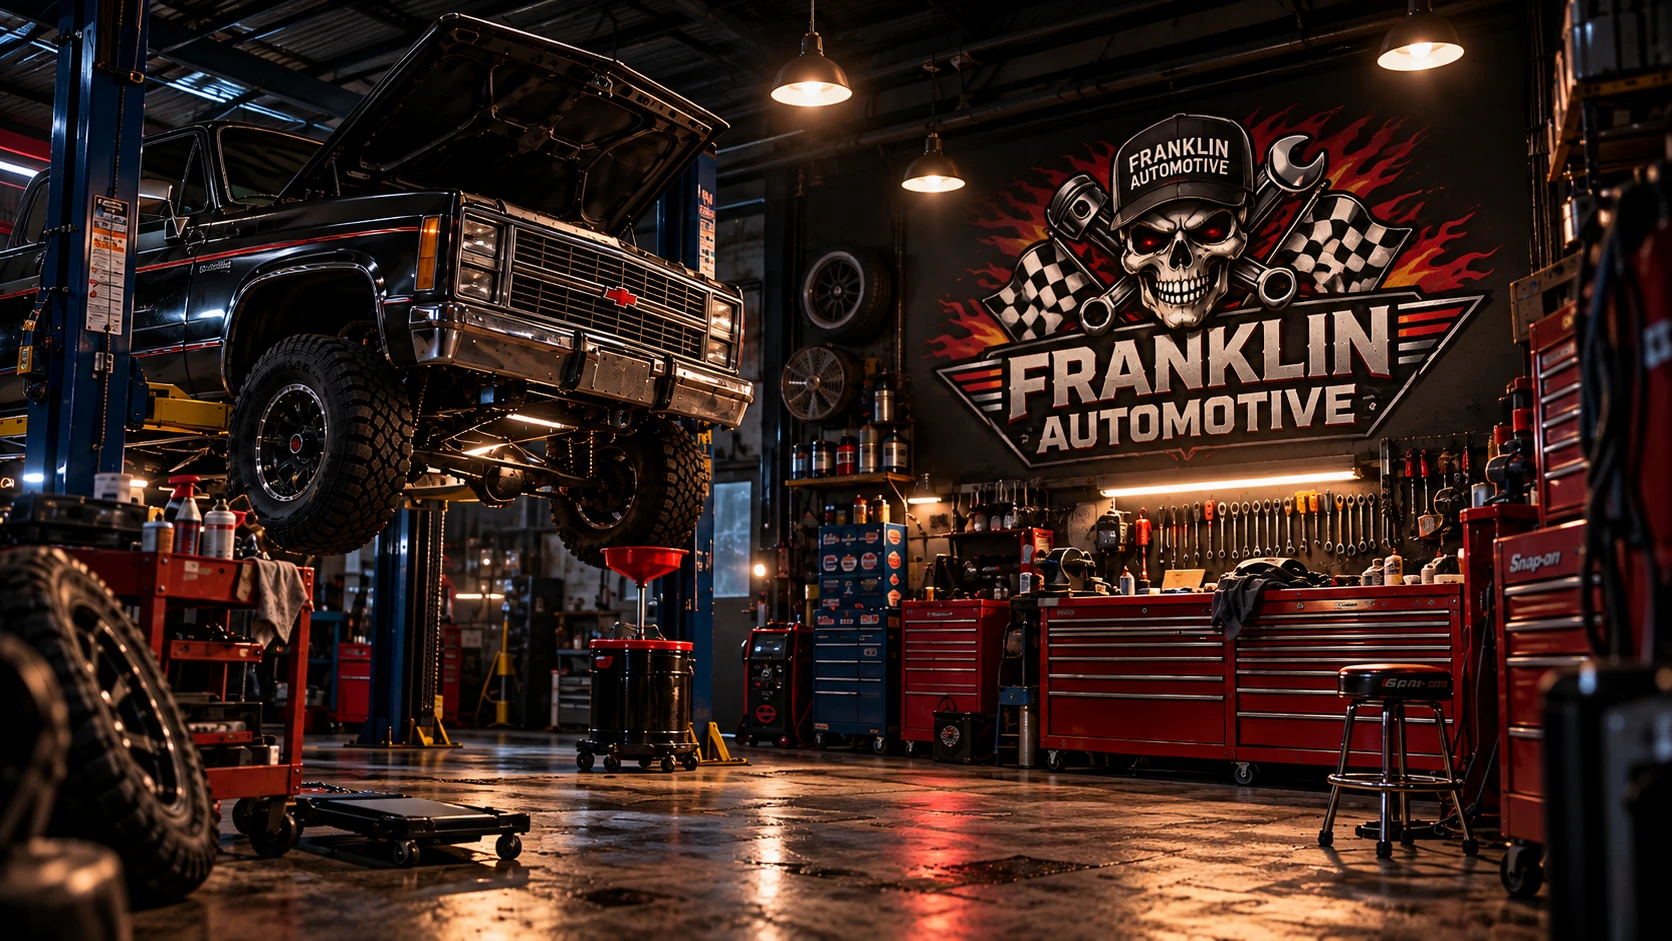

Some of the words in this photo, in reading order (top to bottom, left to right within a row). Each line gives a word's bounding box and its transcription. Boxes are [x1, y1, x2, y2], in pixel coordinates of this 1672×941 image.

[1128, 137, 1229, 173] FRANKLIN
[1130, 158, 1230, 190] AUTOMOTIVE
[1008, 305, 1392, 424] FRANKLIN
[1036, 383, 1357, 454] AUTOMOTIVE
[1509, 551, 1561, 573] Snap-on
